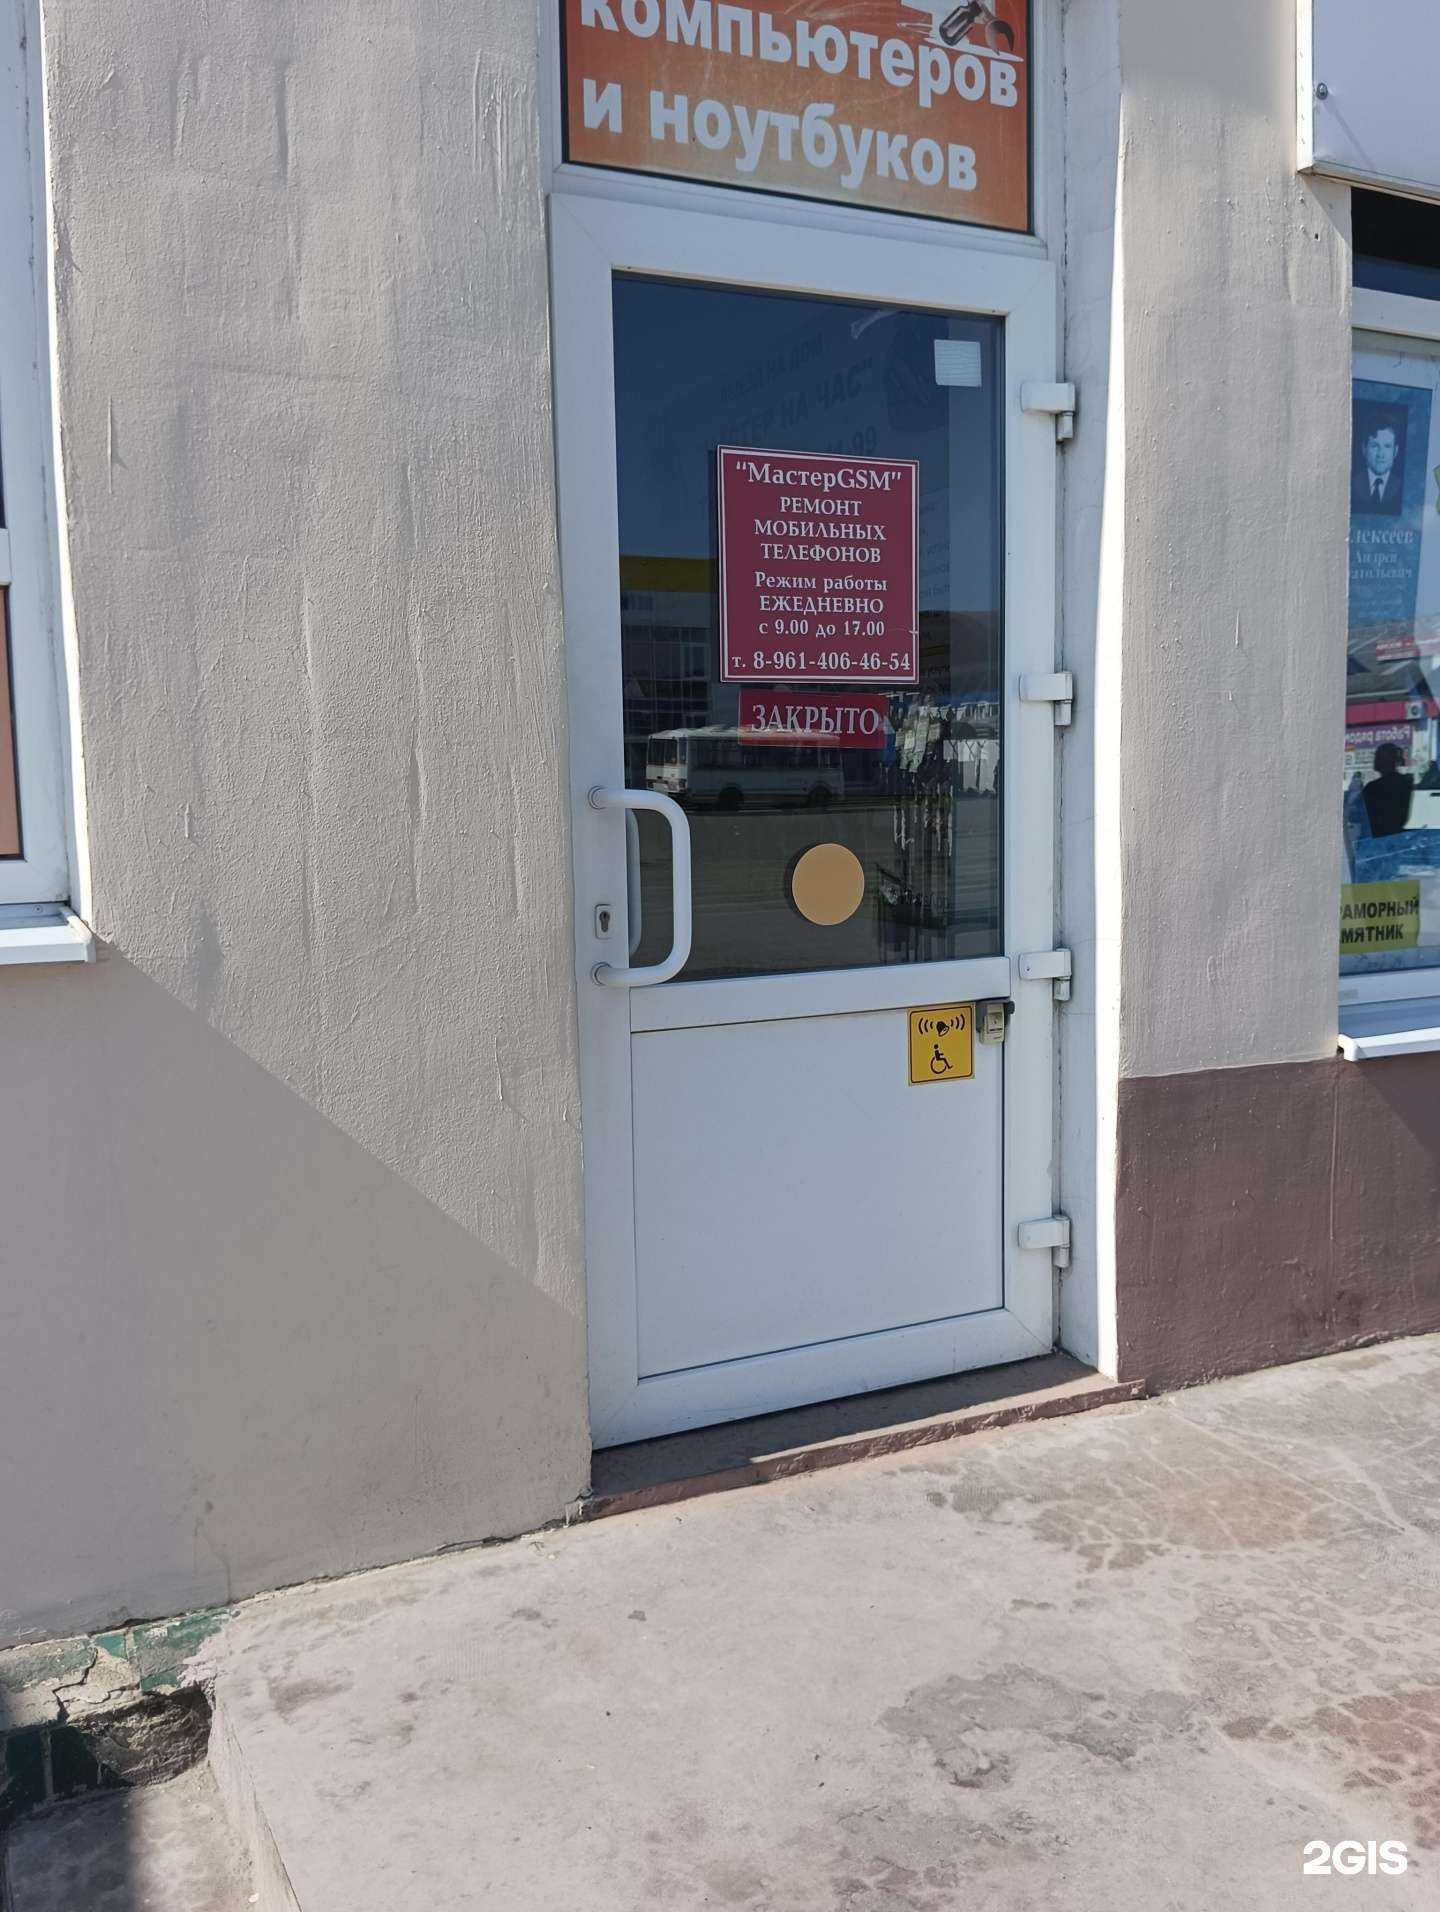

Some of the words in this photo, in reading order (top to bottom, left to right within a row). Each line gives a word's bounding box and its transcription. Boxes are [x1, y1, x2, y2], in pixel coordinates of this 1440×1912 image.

[580, 0, 1018, 108] компьютеров
[582, 77, 623, 134] и
[649, 90, 978, 191] ноутбуков
[780, 496, 862, 517] РЕМОНТ
[754, 519, 887, 541] МОБИЛЬНЫХ
[760, 543, 881, 564] ТЕЛЕФОНОВ
[755, 571, 817, 590] Режим
[823, 574, 888, 593] работы
[759, 595, 884, 615] ЕЖЕДНЕВНО
[758, 622, 768, 635] с
[774, 619, 809, 636] 9.00
[815, 623, 836, 638] до
[843, 620, 885, 637] 17.00
[731, 654, 747, 669] т.
[753, 650, 911, 672] 8-961-406-46-54
[752, 703, 879, 735] ЗАКРЫТО
[1340, 896, 1420, 920] АМОРНЫЙ
[1340, 924, 1404, 944] МЯТНИК
